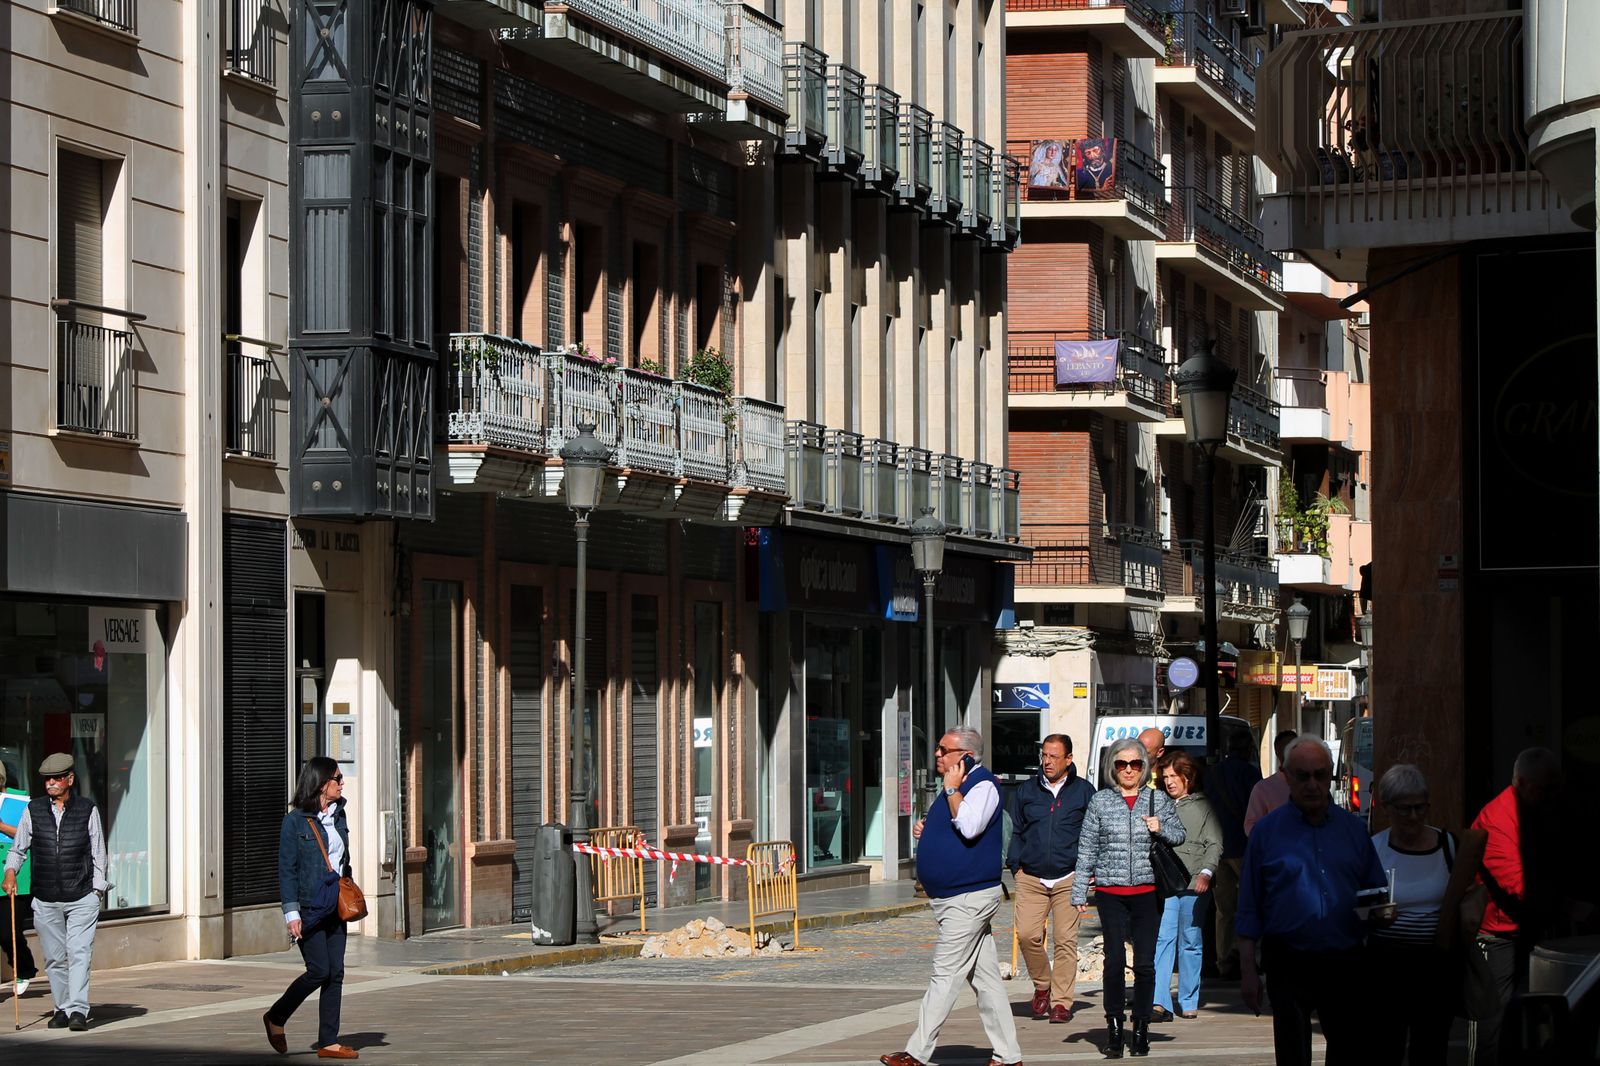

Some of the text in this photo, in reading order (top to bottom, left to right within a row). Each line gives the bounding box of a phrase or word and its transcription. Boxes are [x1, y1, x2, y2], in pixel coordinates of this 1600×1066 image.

[1066, 362, 1105, 371] LEPANTO
[320, 529, 330, 550] LA
[104, 618, 140, 644] VERSACE
[1281, 675, 1312, 684] FOTORIX
[1105, 726, 1206, 741] RODGUEZ
